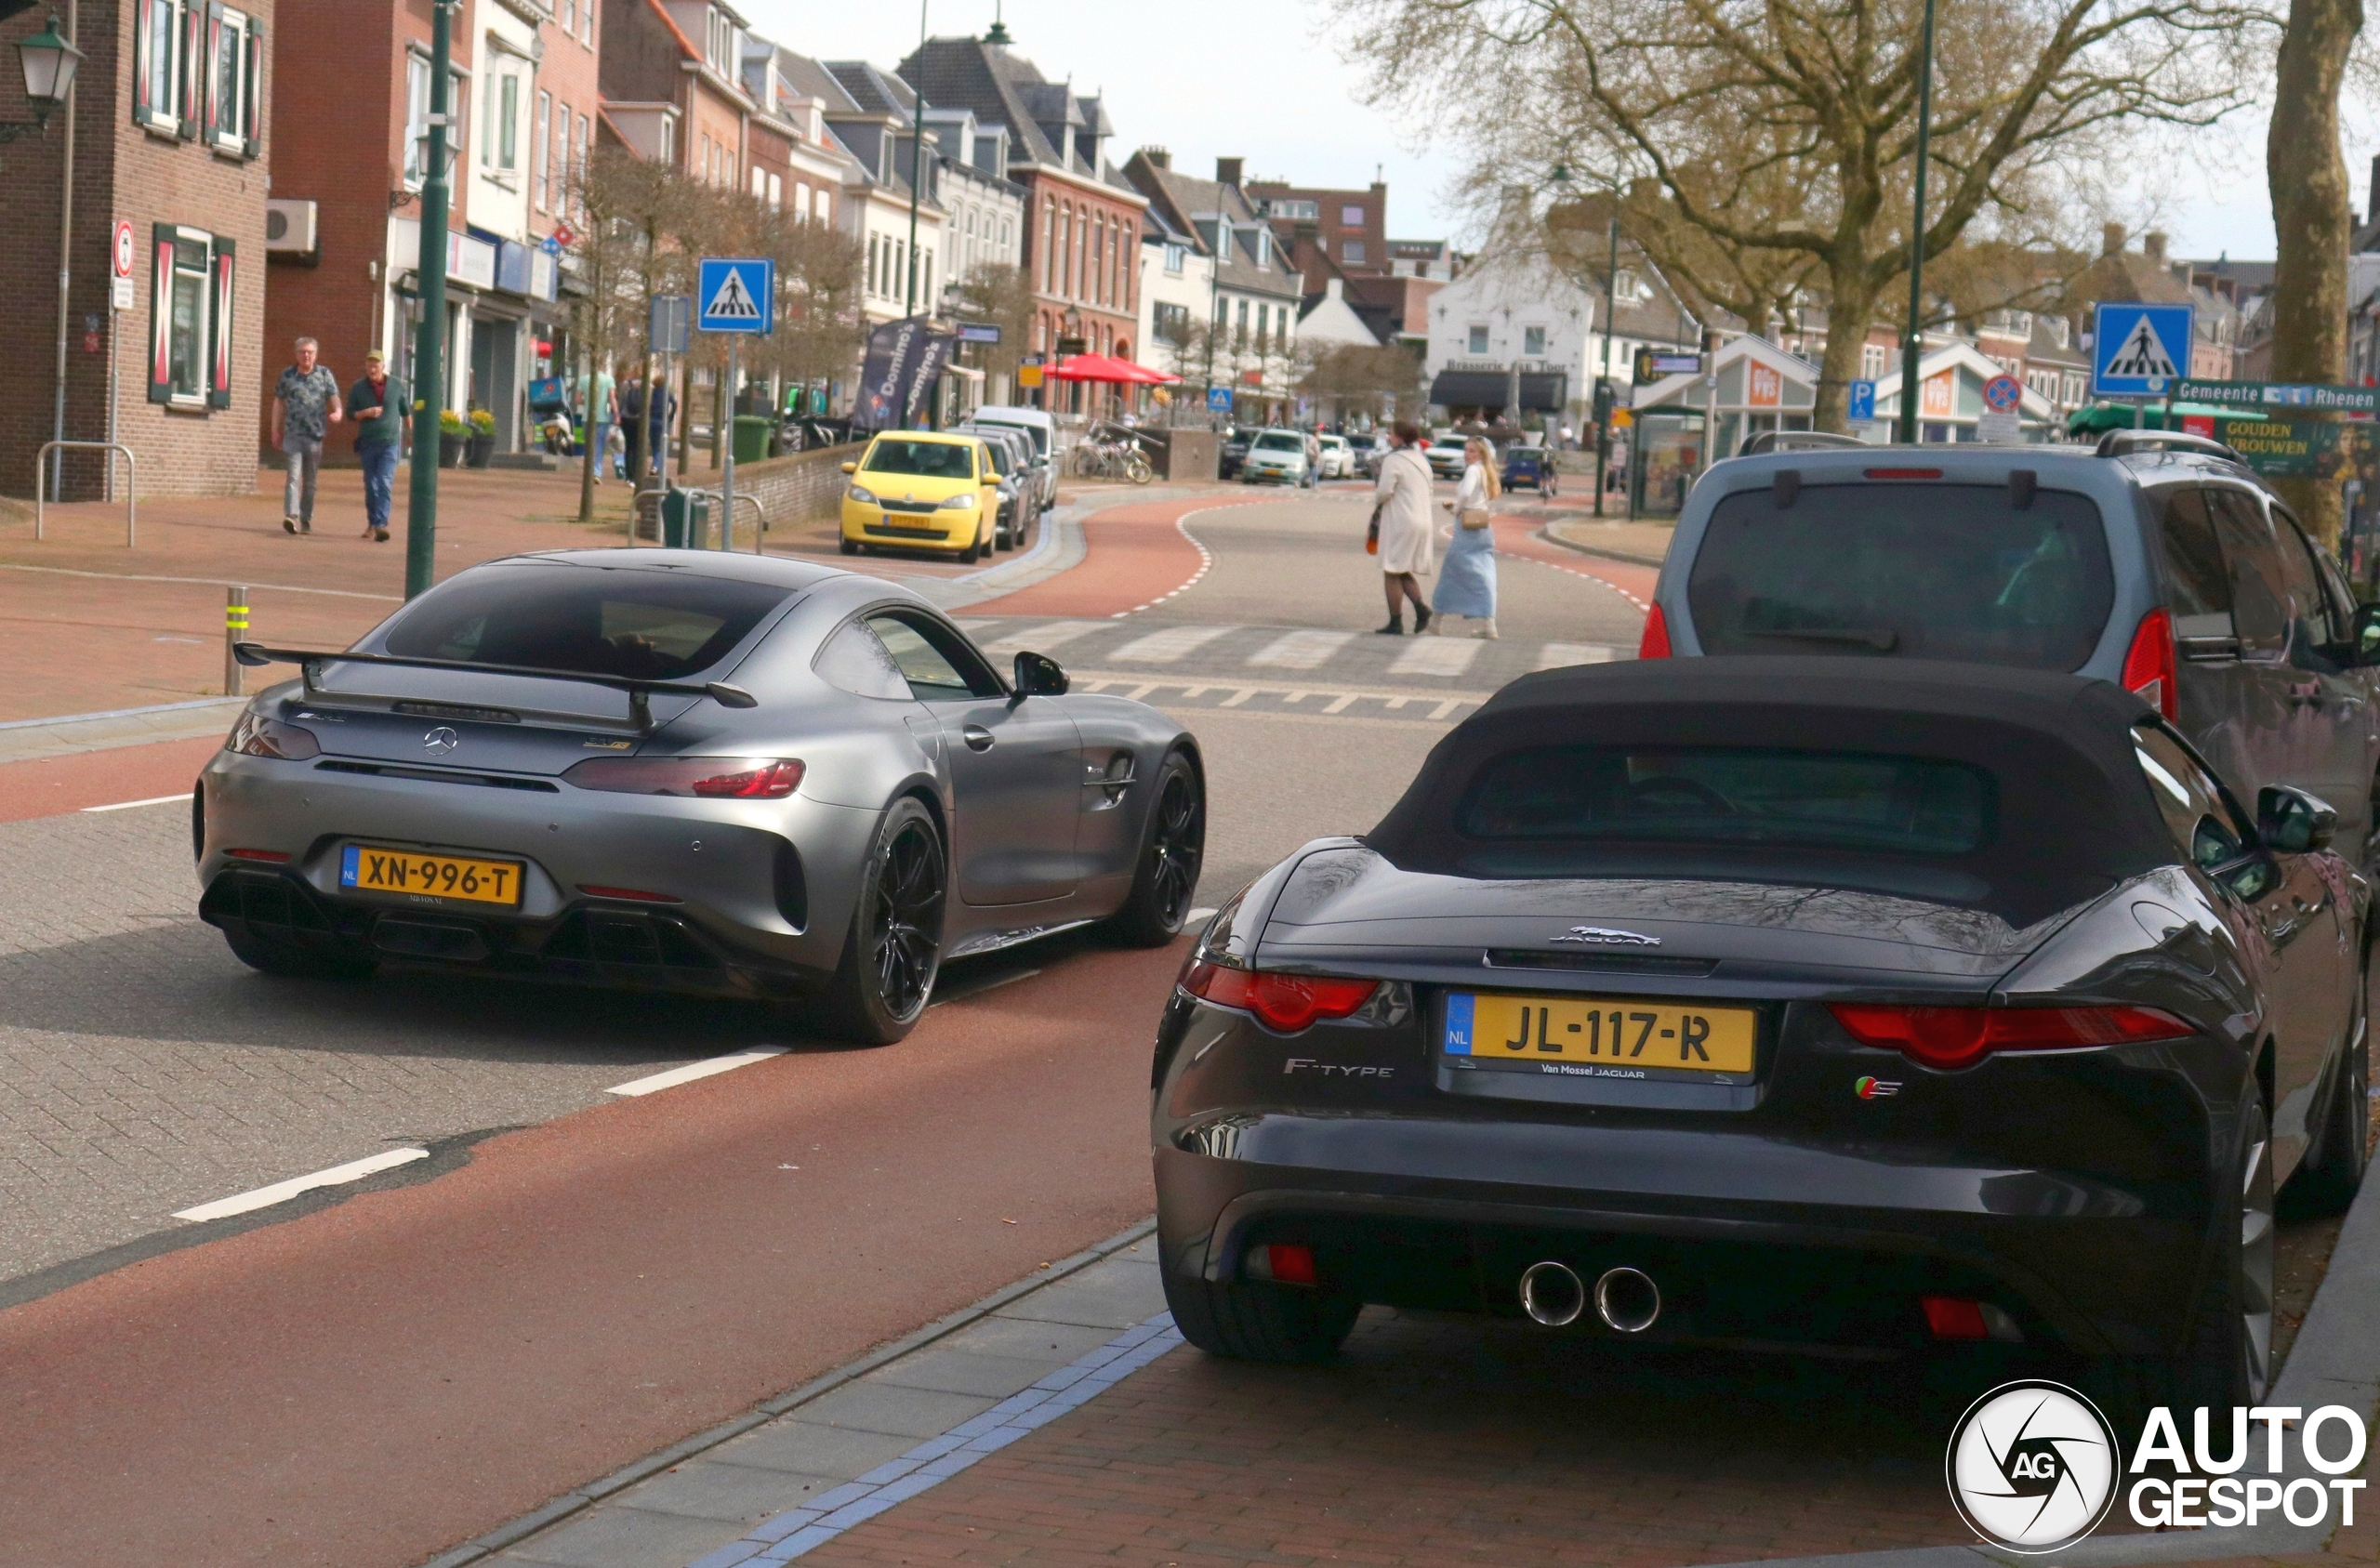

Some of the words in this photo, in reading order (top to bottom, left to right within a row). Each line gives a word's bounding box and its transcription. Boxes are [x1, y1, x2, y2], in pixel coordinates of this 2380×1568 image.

[880, 323, 915, 397] Domino's
[1447, 359, 1504, 370] Brasserie
[1856, 384, 1871, 403] P
[2178, 382, 2258, 402] Gemeente
[2316, 389, 2373, 407] Rhenen
[2227, 421, 2292, 437] GOUDEN
[2227, 438, 2307, 455] VROUWEN
[344, 871, 356, 881] NL
[367, 855, 509, 897] XN-996-T
[1549, 936, 1661, 946] JAGUAR
[1448, 1031, 1468, 1046] NL
[1506, 1006, 1711, 1061] JL-117-R
[1283, 1058, 1395, 1078] F-TYPE
[1541, 1064, 1559, 1074] Van
[1561, 1064, 1593, 1076] Mossel
[1595, 1068, 1646, 1080] JAGUAR
